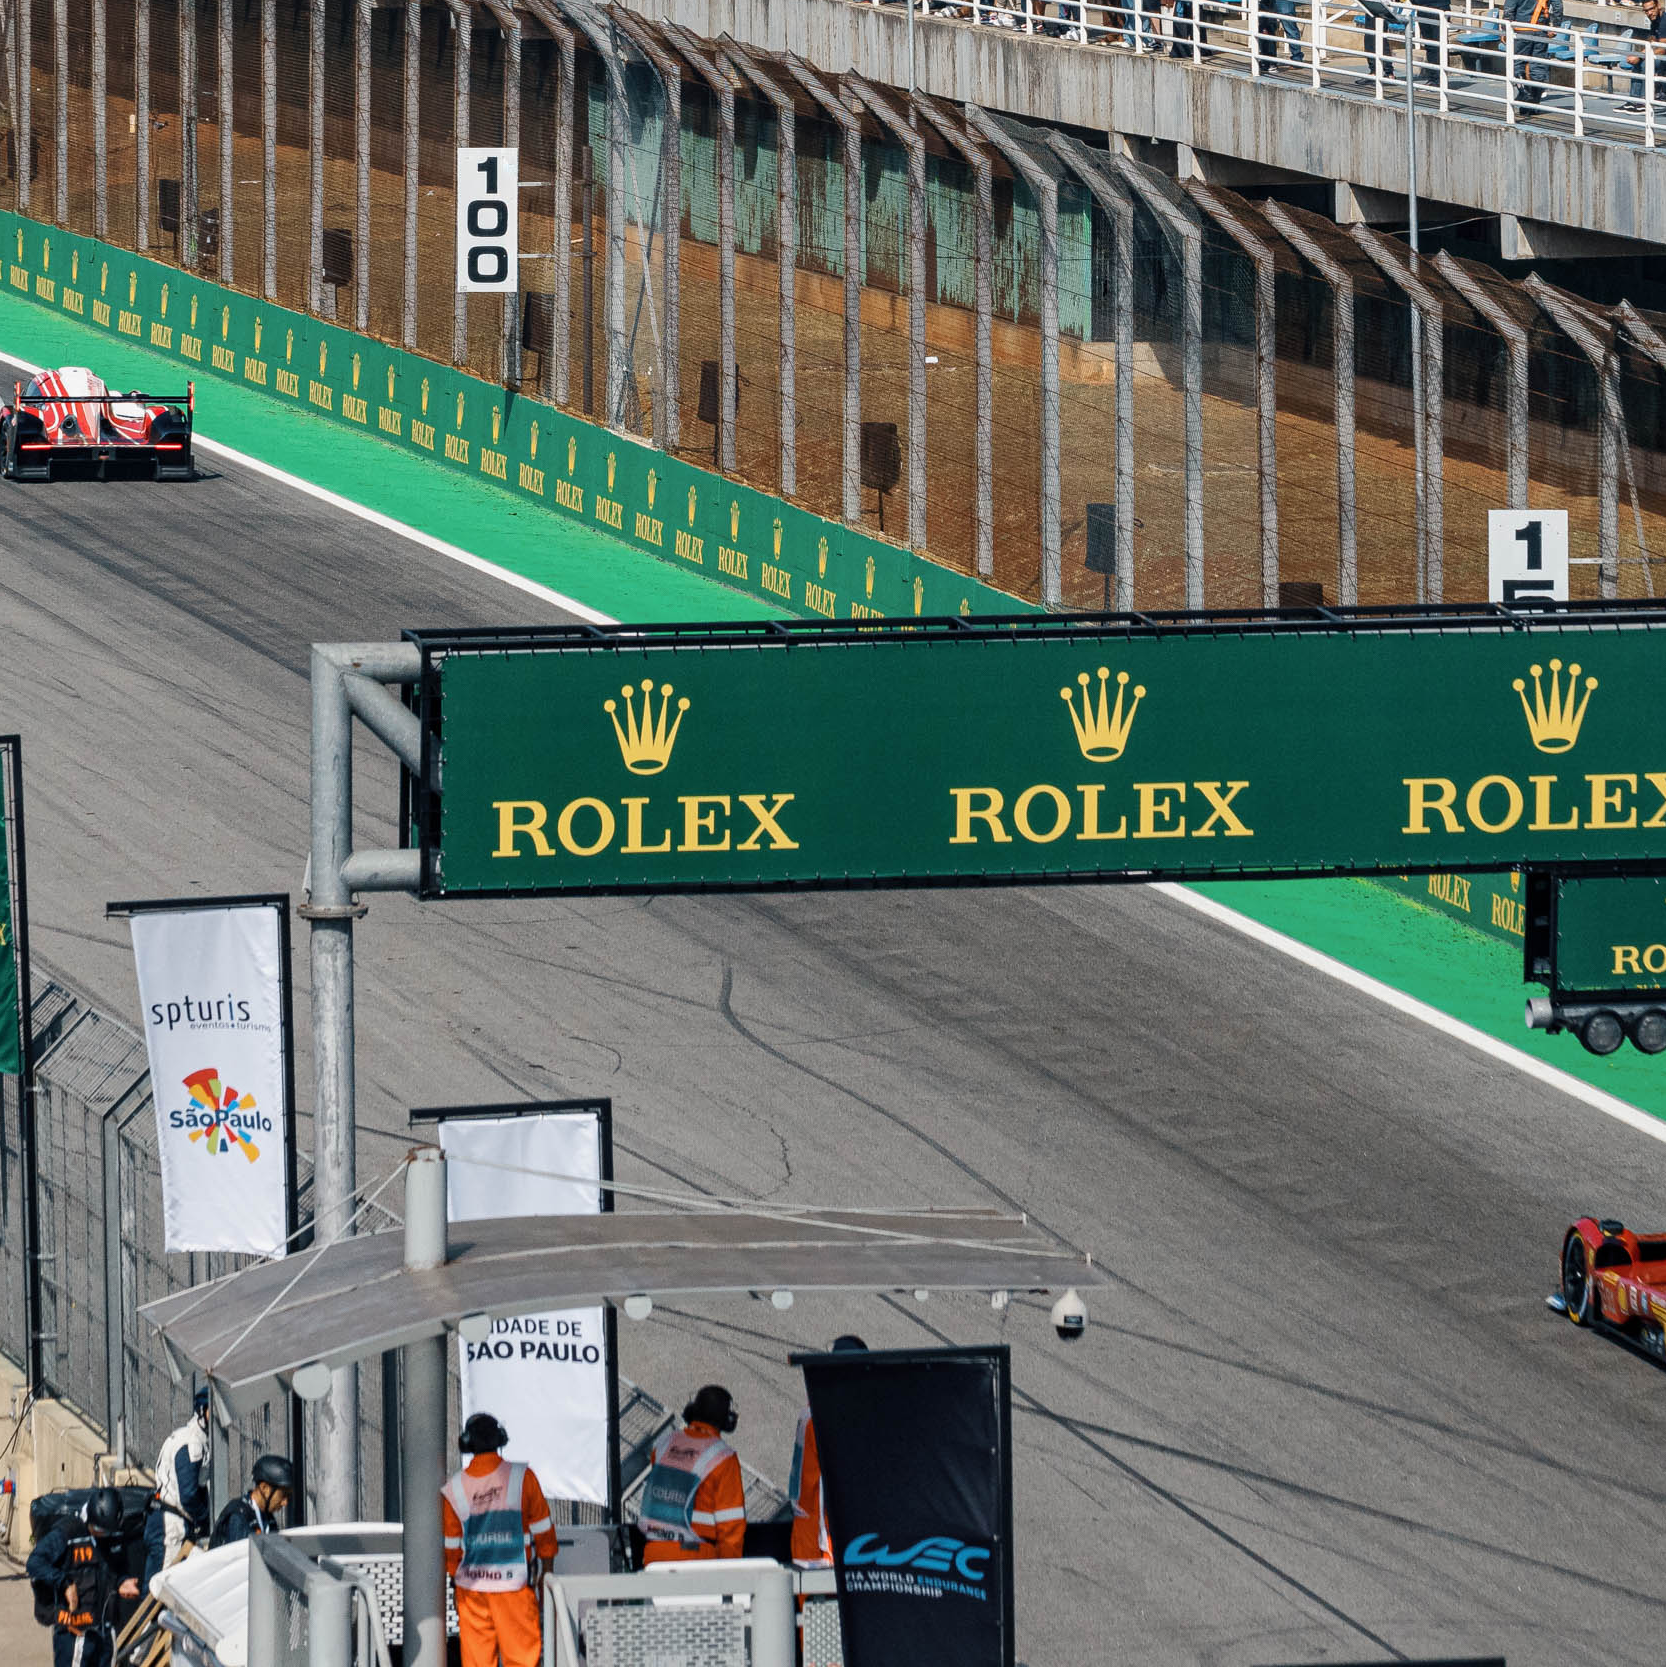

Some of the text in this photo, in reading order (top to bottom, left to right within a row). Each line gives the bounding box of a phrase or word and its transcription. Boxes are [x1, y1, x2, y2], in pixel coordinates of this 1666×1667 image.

[466, 156, 510, 283] 100
[63, 287, 83, 315] ROLEX
[212, 345, 234, 372] ROLEX
[519, 463, 544, 495] ROLEX
[675, 530, 703, 564] ROLEX
[493, 794, 799, 857] ROLEX
[950, 782, 1253, 843] ROLEX
[151, 992, 251, 1031] spturis
[170, 1108, 272, 1132] SãoPaulo
[556, 1319, 582, 1337] DE
[520, 1342, 600, 1364] PAULO
[843, 1533, 990, 1580] WEC
[845, 1571, 987, 1601] FIA WORLD ENDURANCE
[846, 1581, 943, 1598] CHAMPIONSHIP
